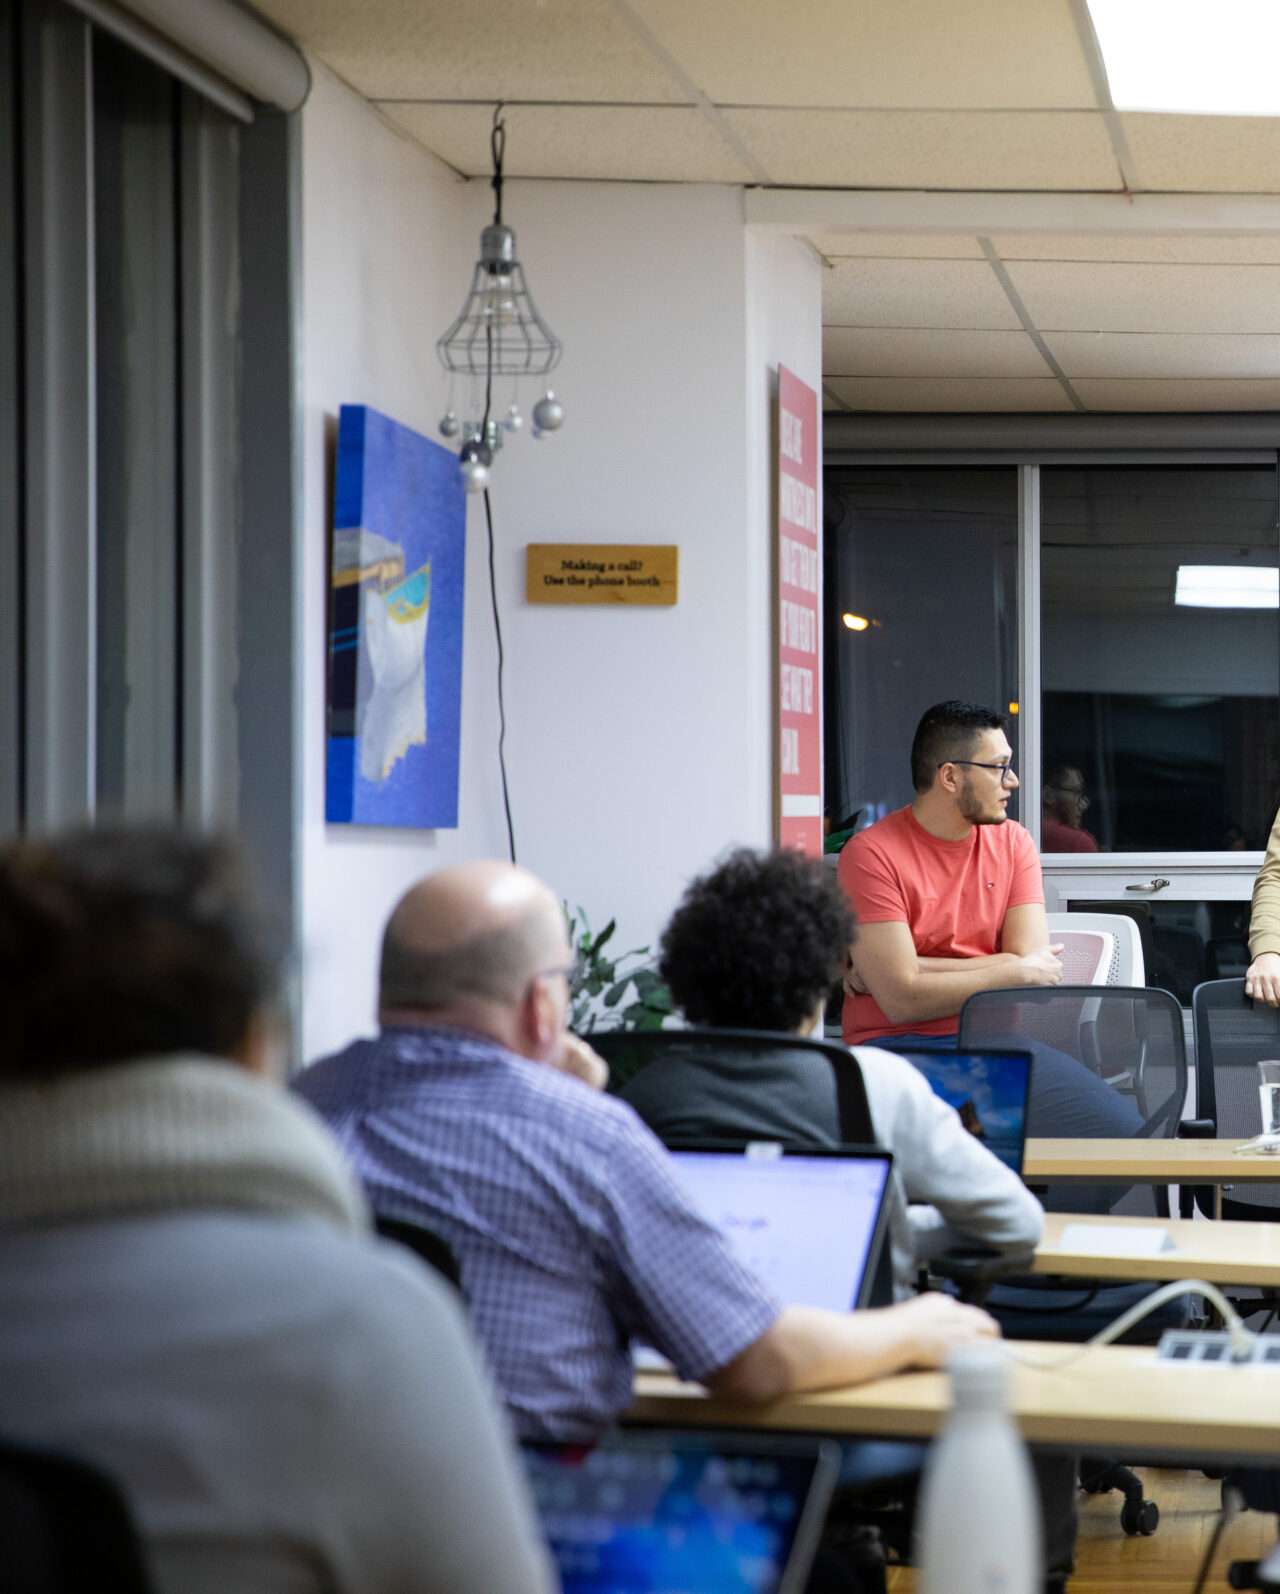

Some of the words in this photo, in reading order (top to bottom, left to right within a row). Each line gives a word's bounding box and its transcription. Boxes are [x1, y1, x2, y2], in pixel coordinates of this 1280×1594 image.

[561, 560, 605, 572] Making
[617, 560, 643, 572] call?
[543, 575, 564, 586] Use
[567, 575, 585, 586] the
[588, 576, 624, 588] phone
[627, 576, 660, 587] booth
